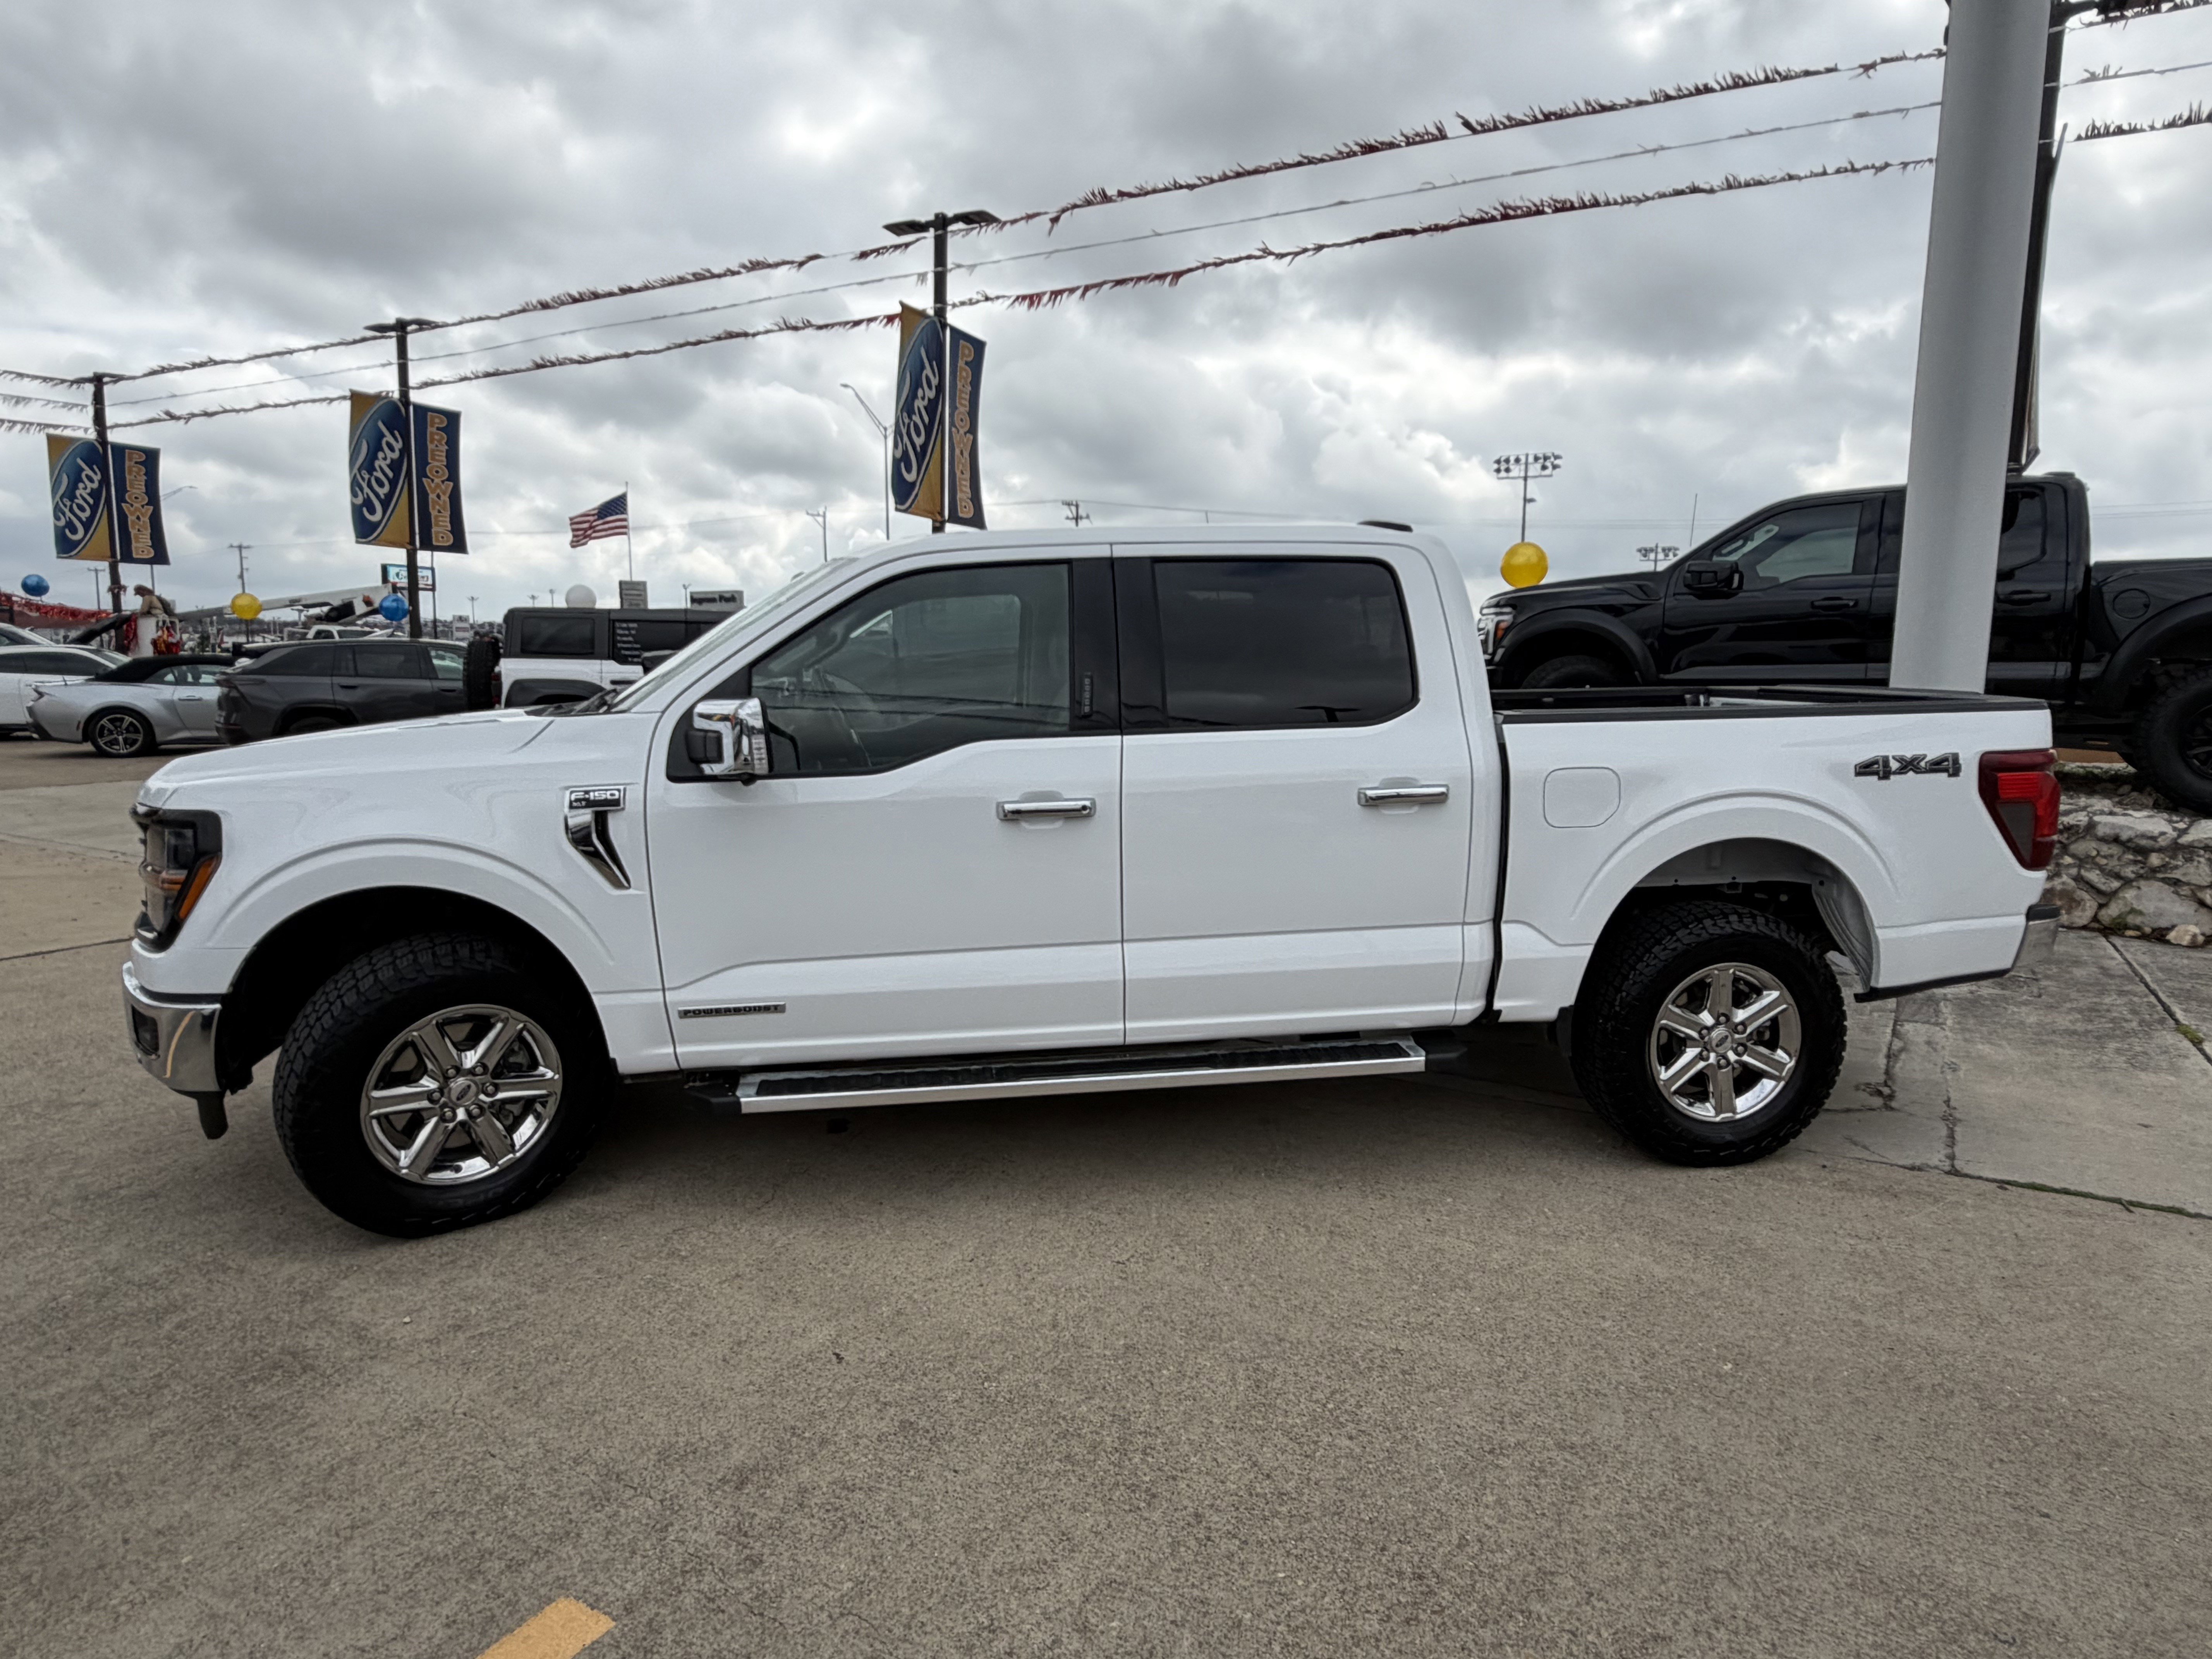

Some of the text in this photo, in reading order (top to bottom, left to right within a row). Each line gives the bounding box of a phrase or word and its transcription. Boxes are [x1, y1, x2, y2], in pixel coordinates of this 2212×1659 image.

[893, 347, 939, 483] Ford
[53, 457, 102, 541] Ford
[350, 420, 403, 522] Ford
[571, 790, 619, 801] F-150
